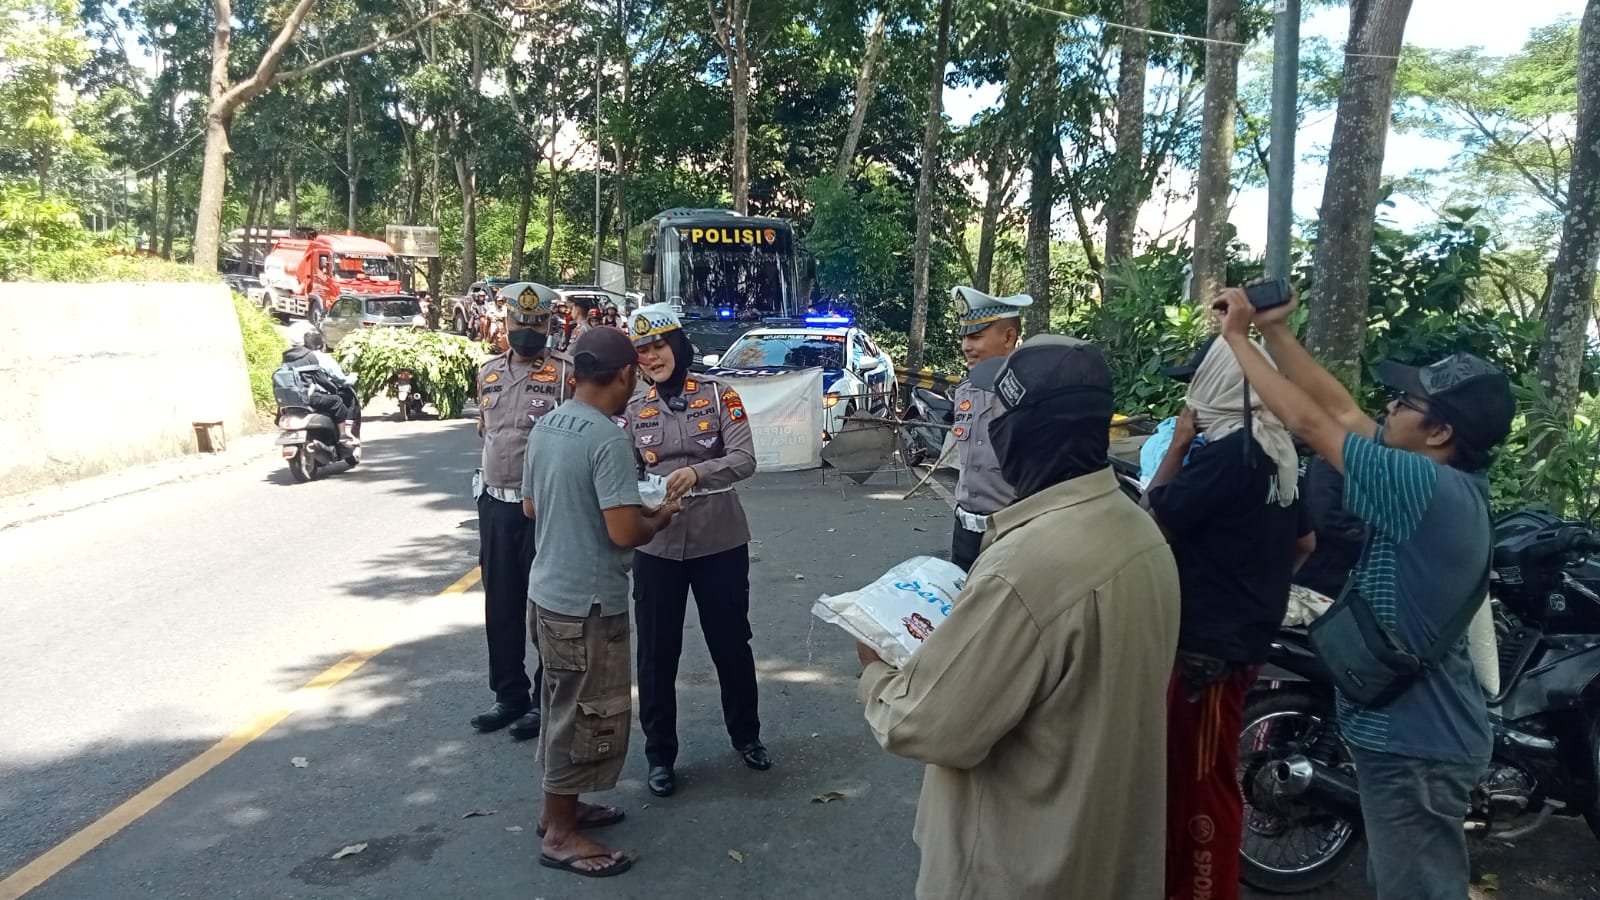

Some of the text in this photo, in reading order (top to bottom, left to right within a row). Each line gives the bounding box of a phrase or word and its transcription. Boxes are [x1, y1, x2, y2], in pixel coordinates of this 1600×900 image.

[691, 228, 762, 244] POLISI
[525, 384, 556, 394] POLRI
[686, 407, 715, 420] POLRI
[635, 421, 659, 430] ARUM
